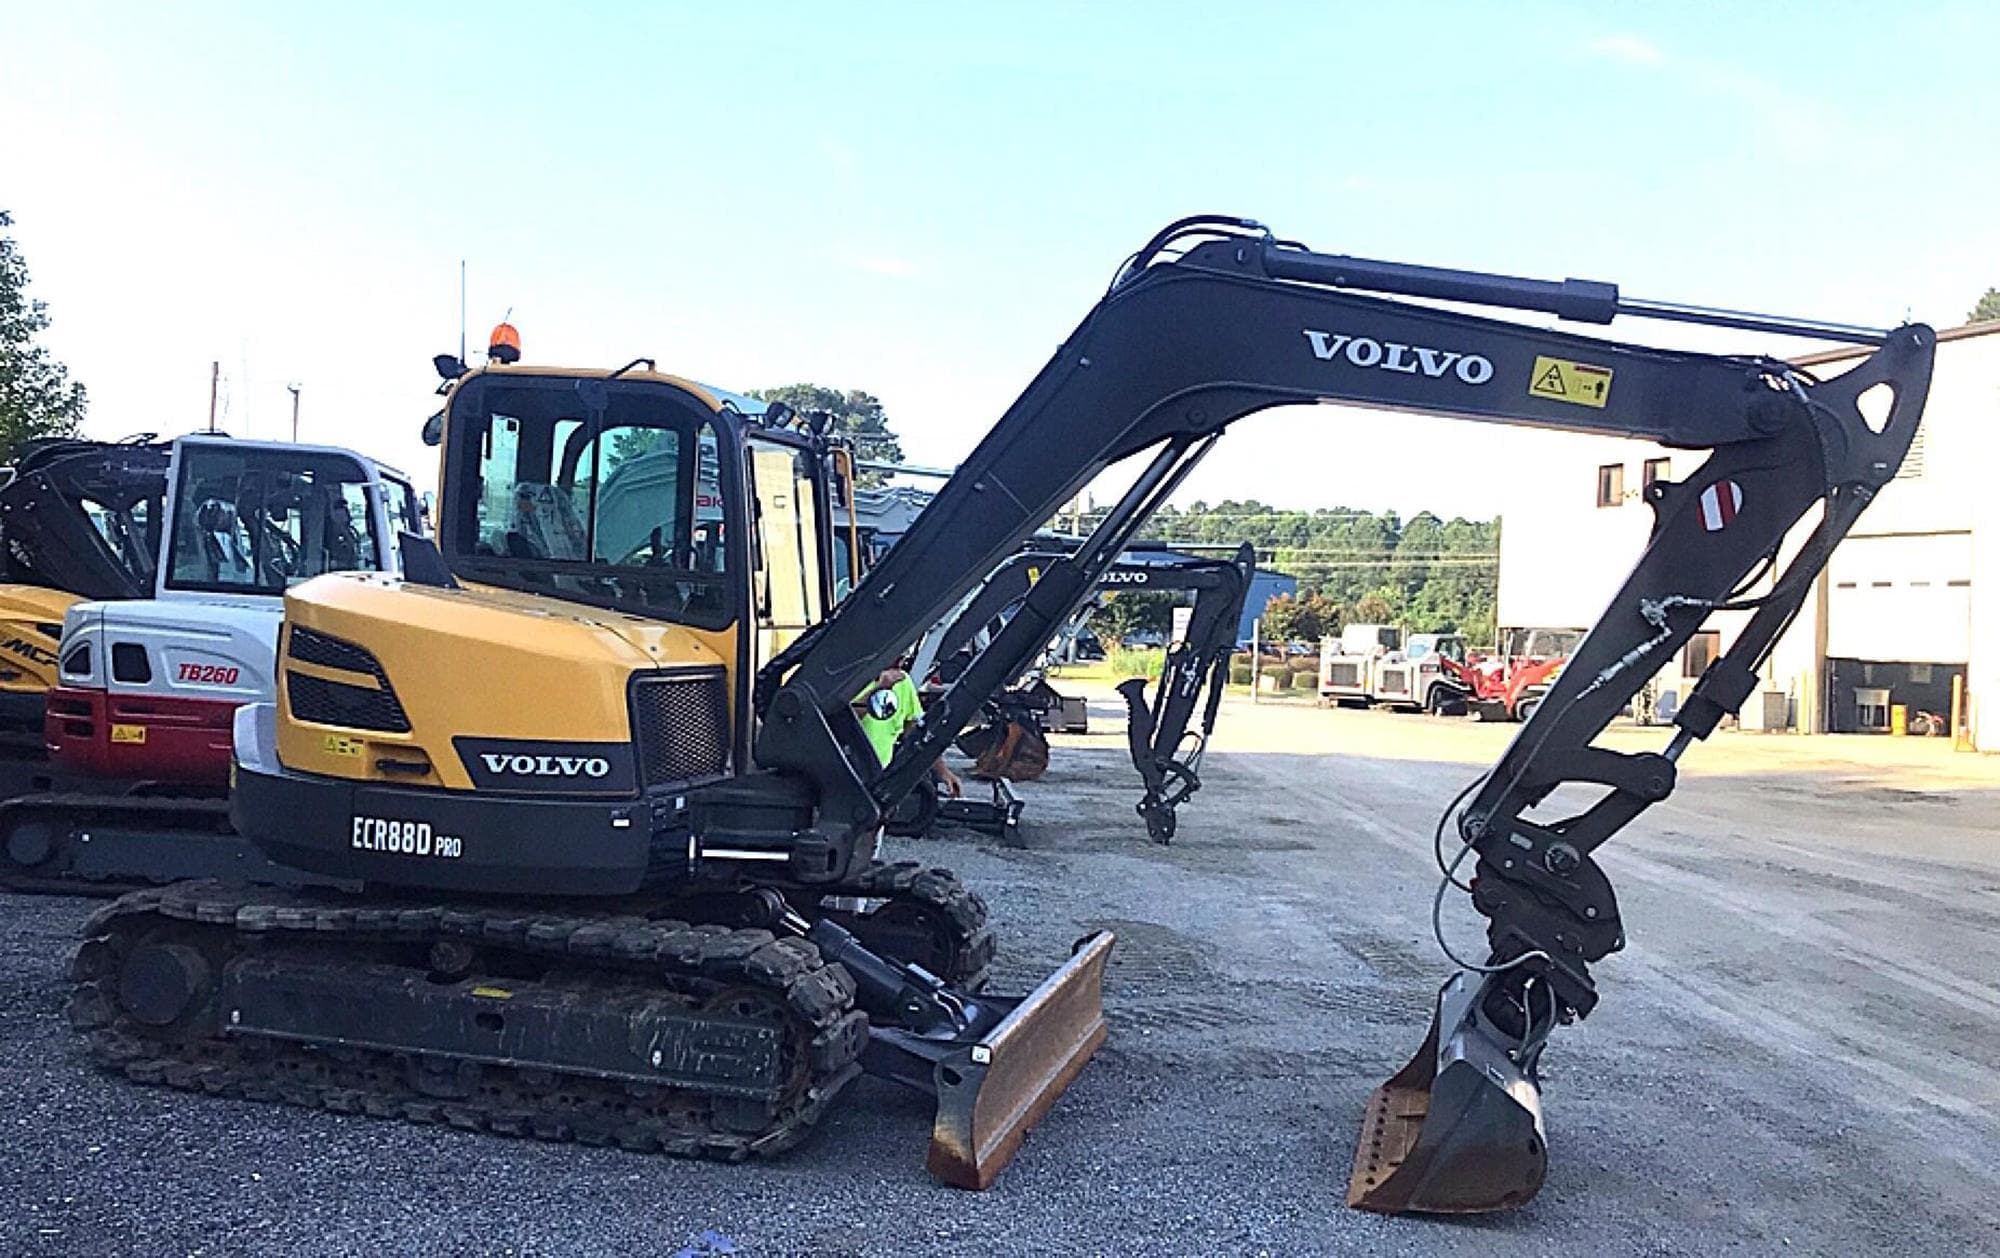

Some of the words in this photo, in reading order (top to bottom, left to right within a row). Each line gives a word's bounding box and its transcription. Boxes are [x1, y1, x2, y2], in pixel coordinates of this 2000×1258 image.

[1302, 329, 1494, 384] VOLVO
[178, 663, 239, 684] TB260
[479, 754, 610, 777] VOLVO
[352, 816, 431, 855] ECR88D
[434, 836, 462, 857] PRO
